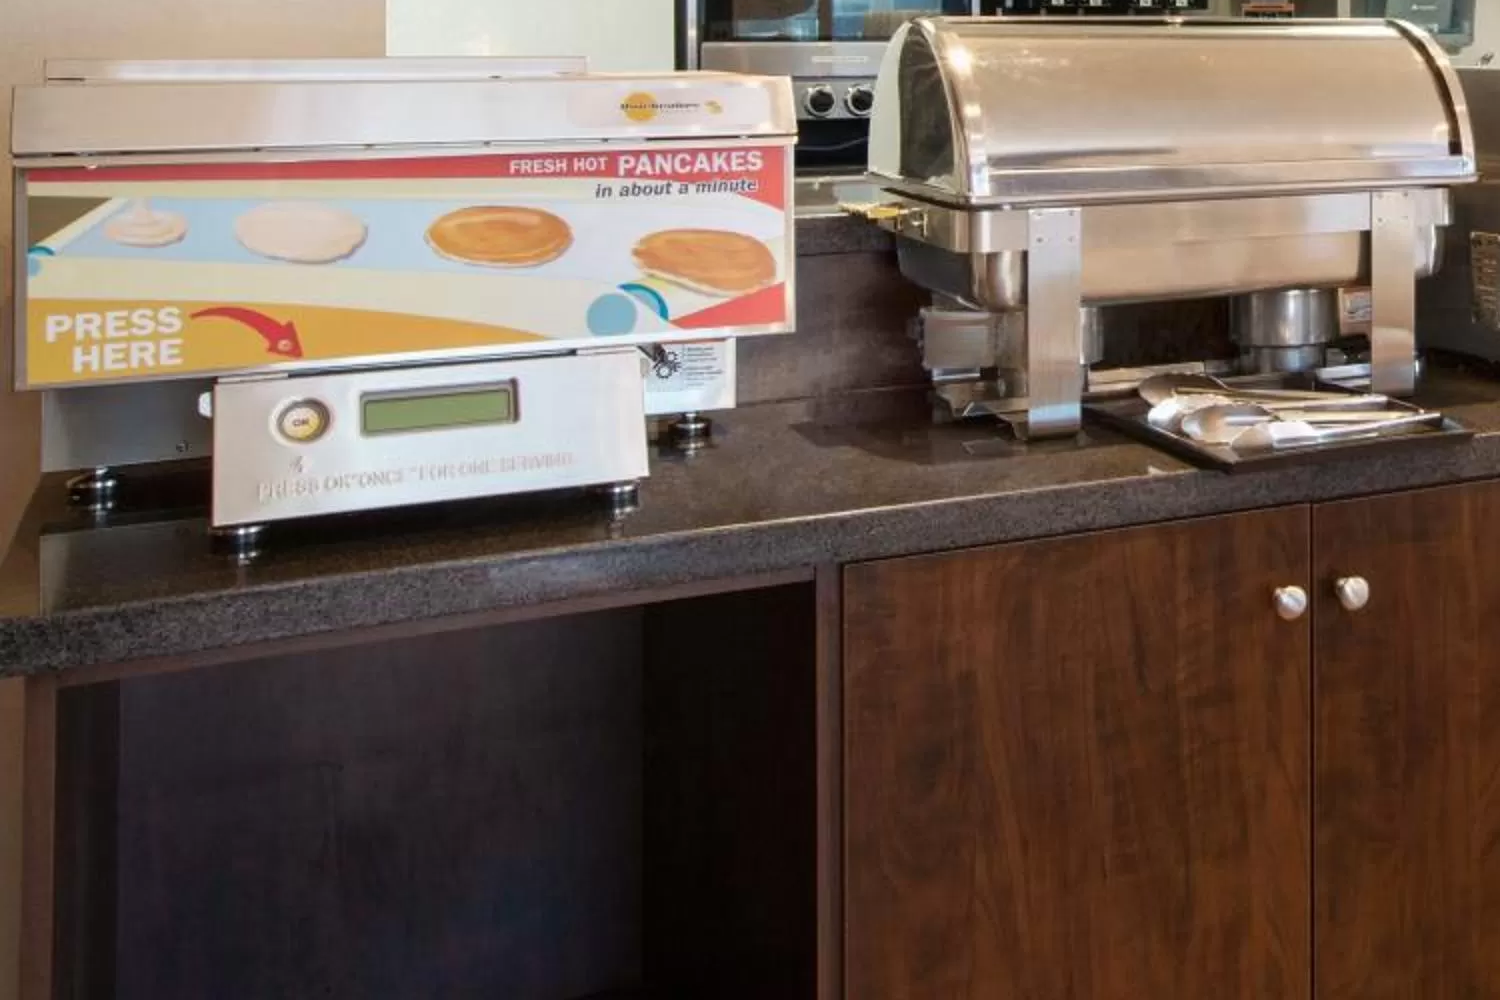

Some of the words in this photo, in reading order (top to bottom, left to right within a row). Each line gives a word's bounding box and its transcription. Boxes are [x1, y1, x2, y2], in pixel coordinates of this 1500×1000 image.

[509, 157, 567, 174] FRESH
[573, 156, 608, 171] HOT
[617, 150, 764, 176] PANCAKES
[595, 183, 612, 198] in
[619, 180, 672, 197] about
[678, 182, 689, 194] a
[695, 179, 758, 193] minute
[45, 305, 183, 343] PRESS
[72, 338, 184, 374] HERE
